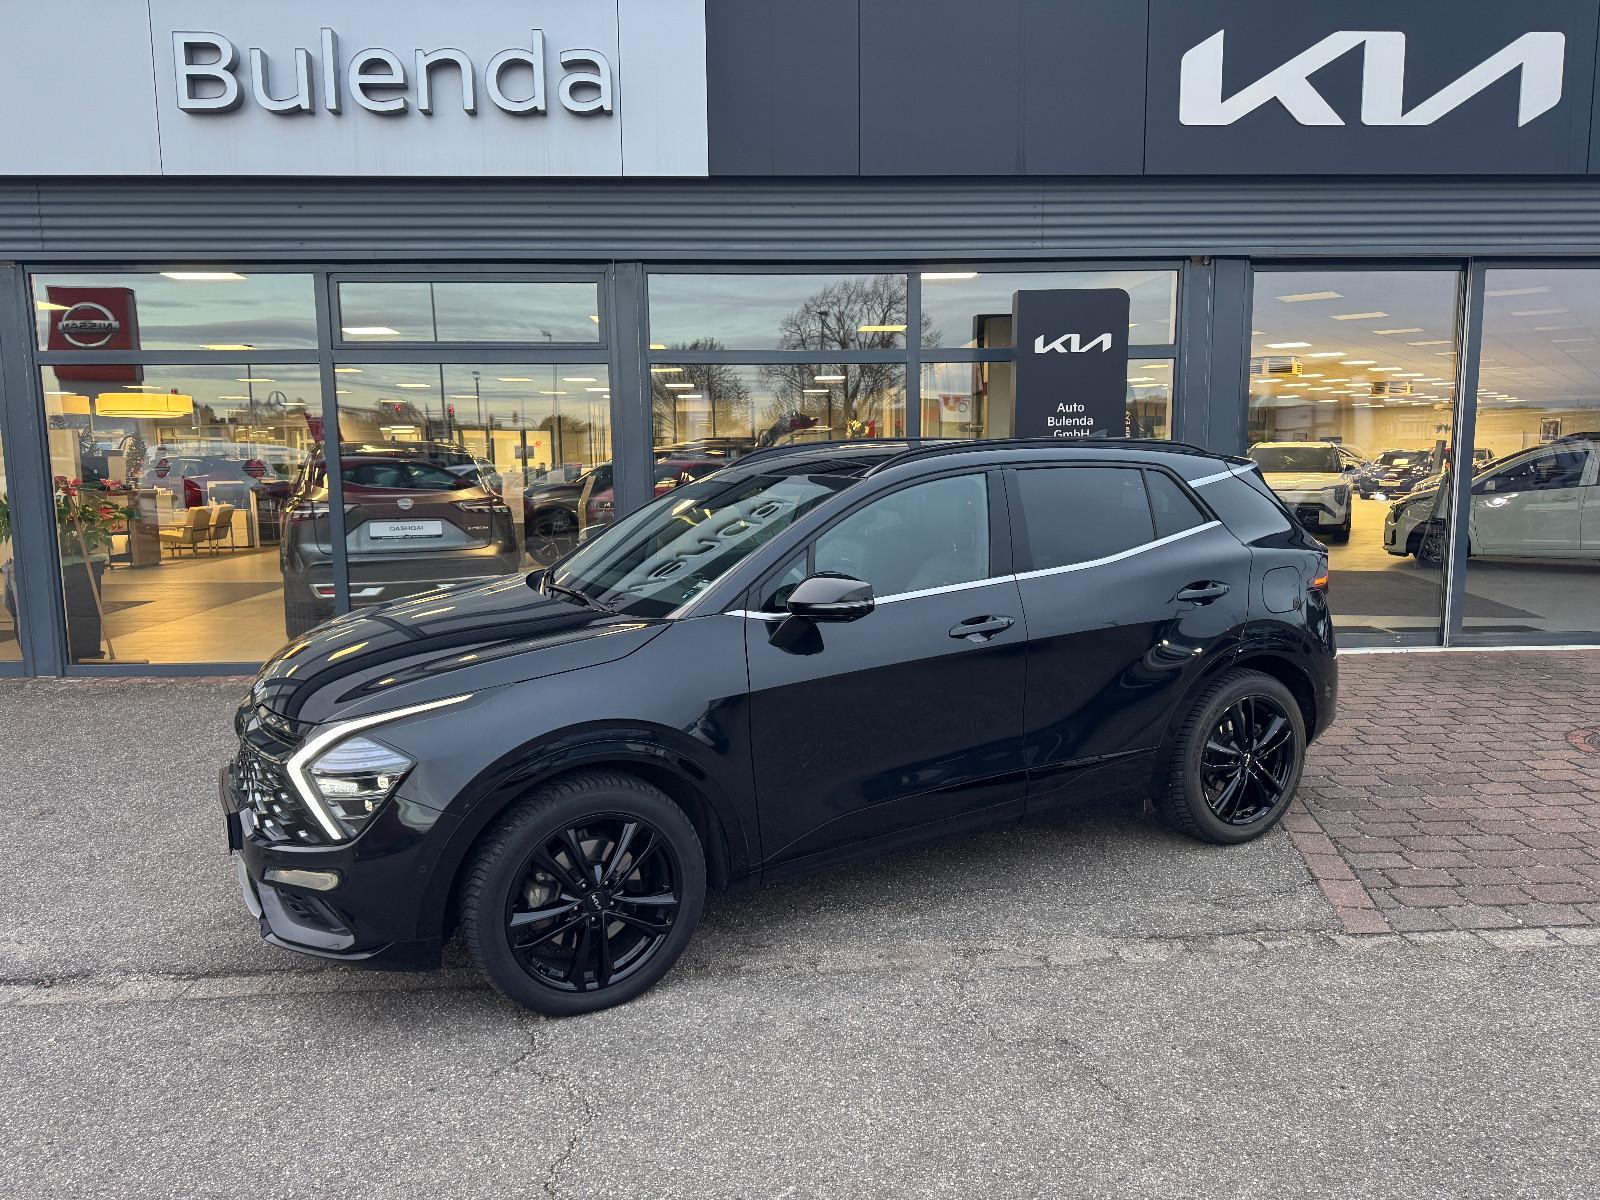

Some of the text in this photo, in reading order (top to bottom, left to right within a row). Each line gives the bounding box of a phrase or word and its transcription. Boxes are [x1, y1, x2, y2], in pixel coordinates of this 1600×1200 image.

[171, 27, 614, 115] Bulenda
[1179, 29, 1566, 128] KIA
[1034, 333, 1112, 353] KIA
[1056, 402, 1085, 412] Auto
[1047, 416, 1094, 427] Bulenda
[1053, 429, 1090, 437] GmbH
